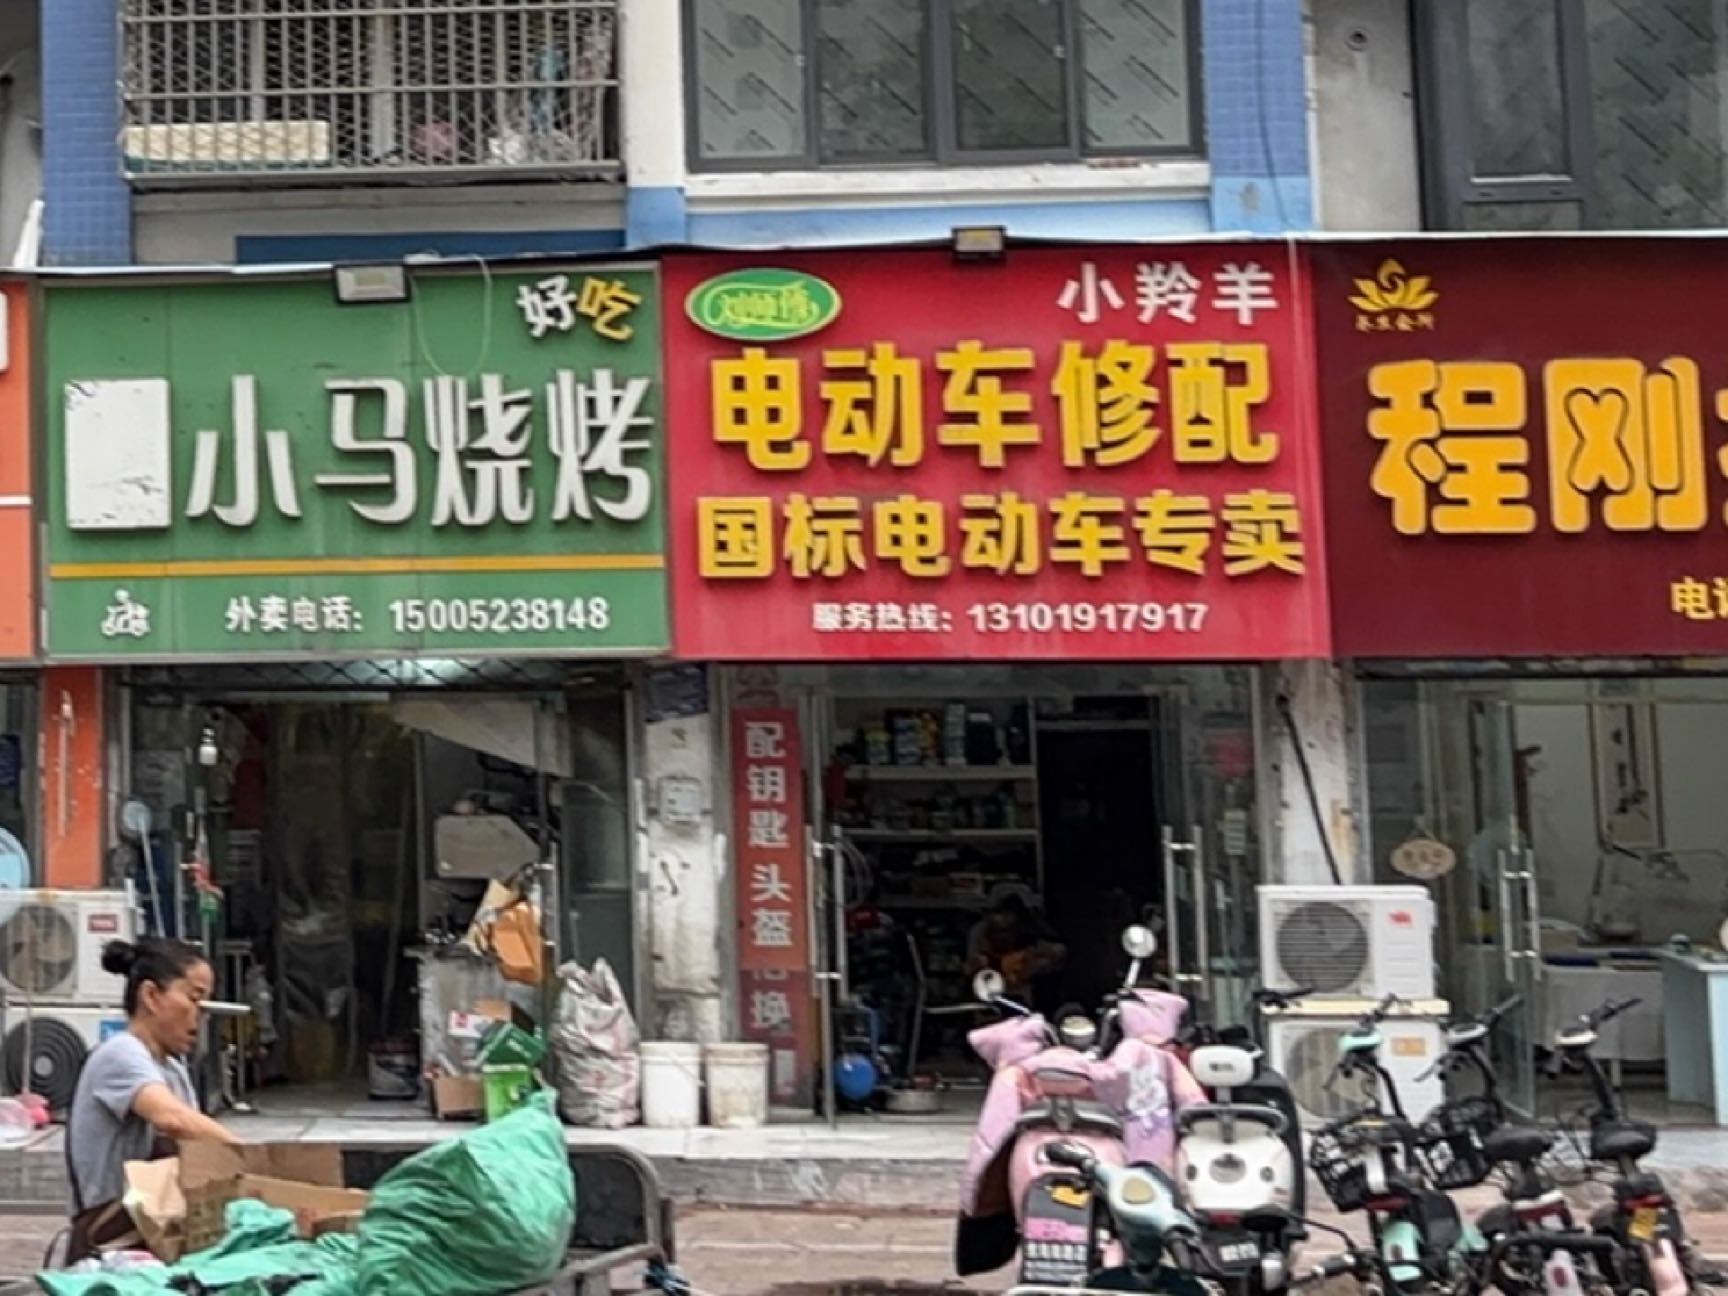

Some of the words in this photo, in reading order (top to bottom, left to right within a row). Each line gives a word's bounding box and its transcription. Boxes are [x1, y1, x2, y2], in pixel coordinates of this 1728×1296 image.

[517, 275, 641, 341] 好吃
[1058, 262, 1278, 325] 小羚羊
[185, 368, 655, 527] 小马烧烤
[710, 340, 1280, 471] 电动车修配
[1368, 356, 1728, 536] 程刚
[696, 489, 1306, 580] 国标电动车专卖
